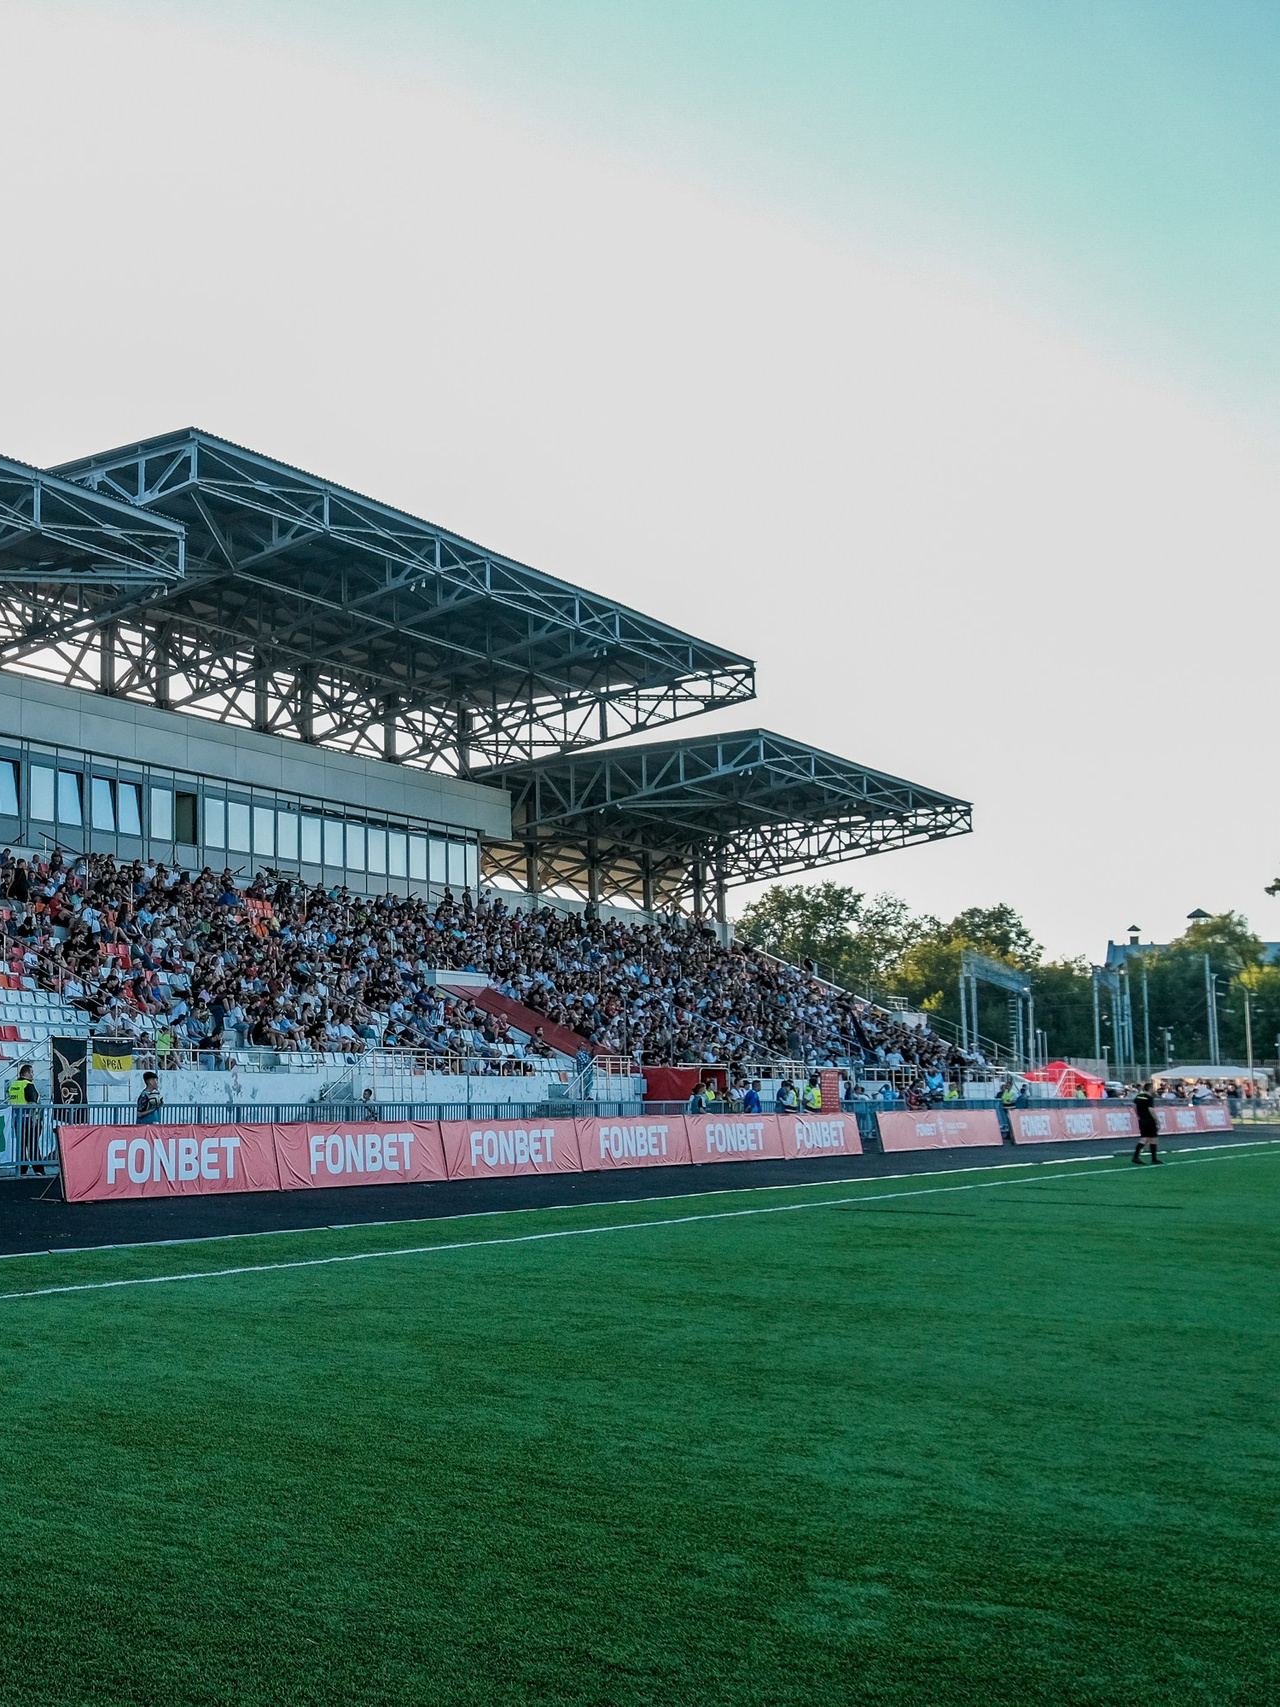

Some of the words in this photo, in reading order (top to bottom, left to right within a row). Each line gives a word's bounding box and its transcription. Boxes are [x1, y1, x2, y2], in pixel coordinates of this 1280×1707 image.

[794, 1120, 845, 1149] FONBET
[1019, 1114, 1051, 1137] FONBET
[1065, 1113, 1094, 1135] FONBET
[1106, 1111, 1132, 1132] FONBET
[470, 1129, 555, 1167] FONBET
[599, 1125, 669, 1159] FONBET
[706, 1122, 765, 1153] FONBET
[107, 1137, 240, 1184] FONBET
[310, 1133, 414, 1175] FONBET
